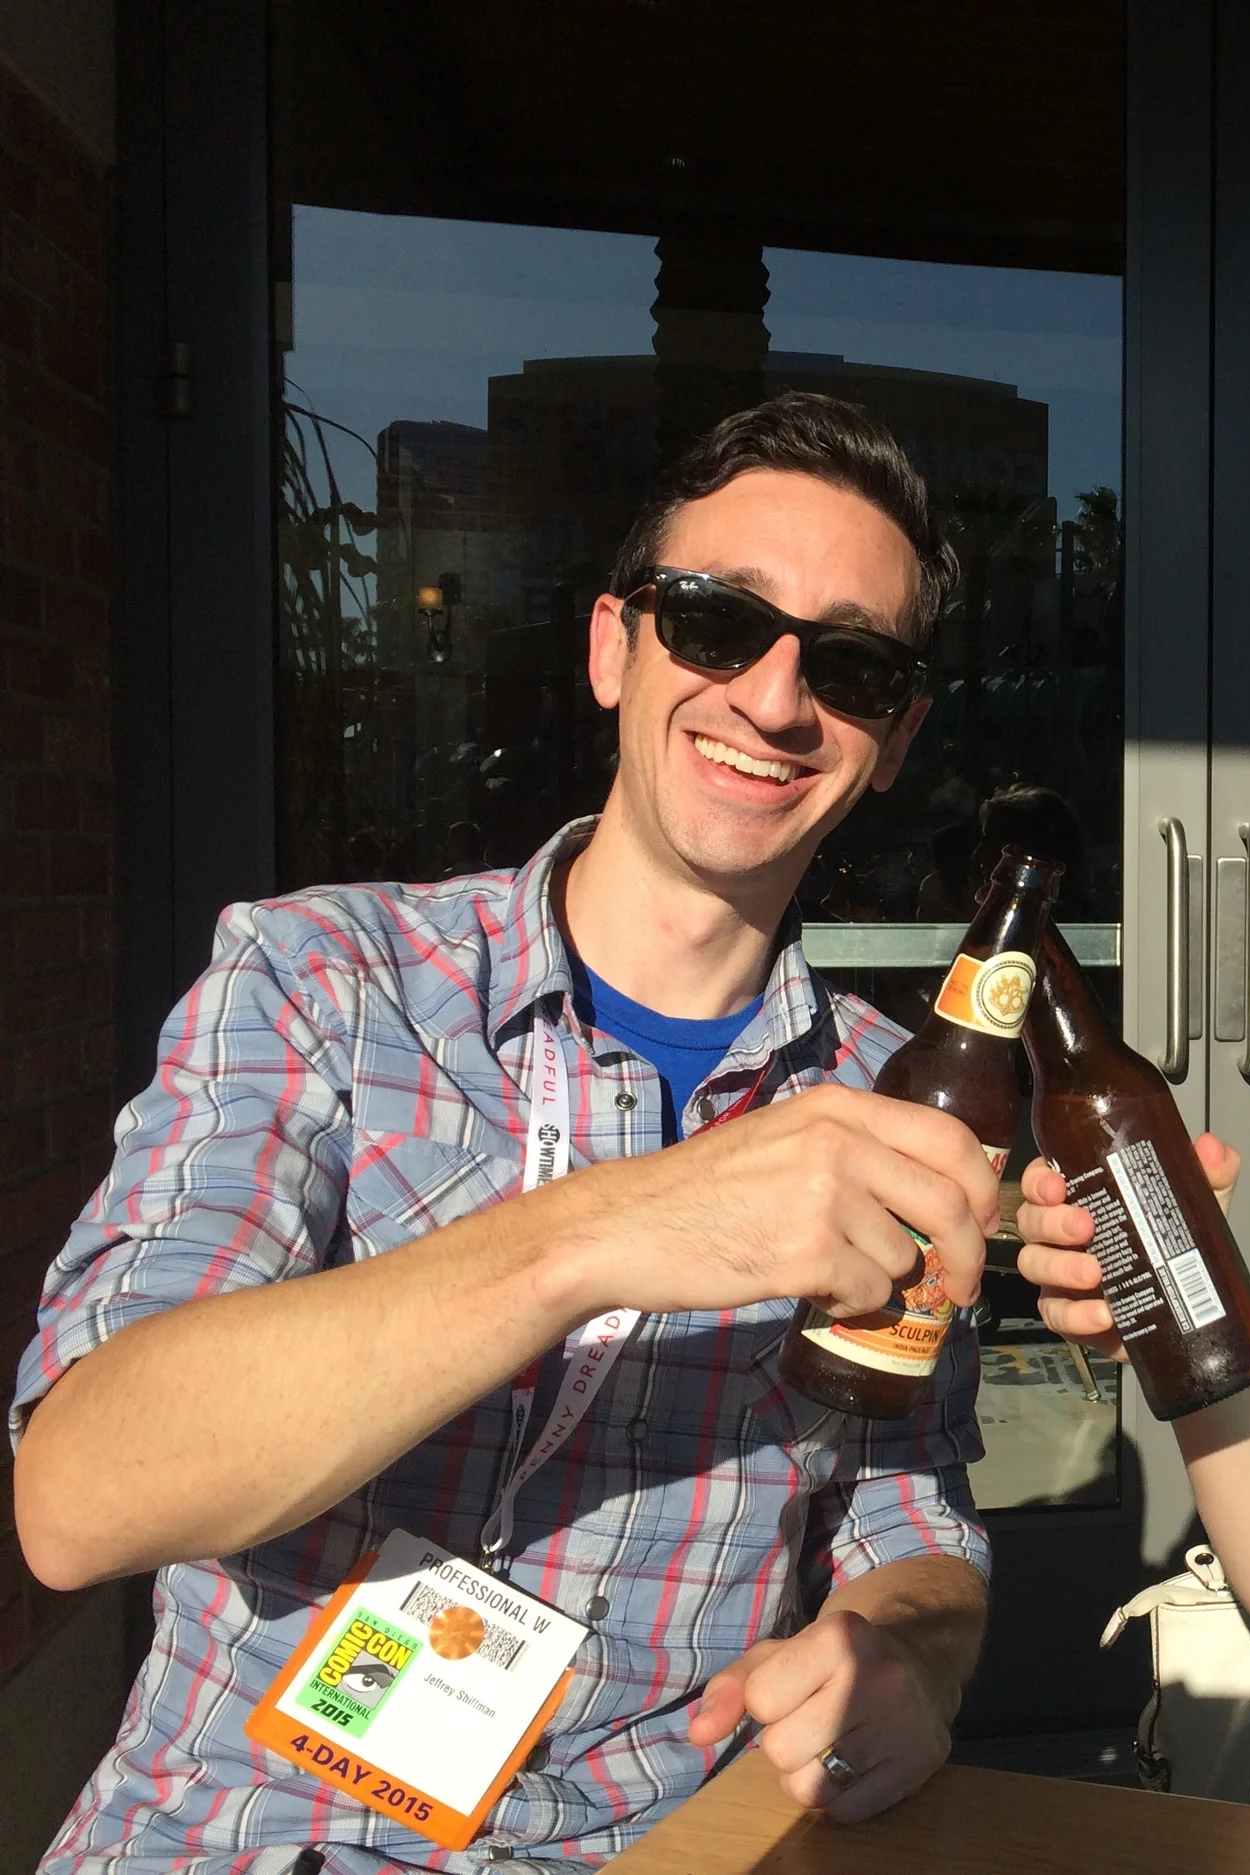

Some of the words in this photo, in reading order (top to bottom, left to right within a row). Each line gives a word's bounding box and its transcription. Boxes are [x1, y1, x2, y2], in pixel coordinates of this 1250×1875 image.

[573, 1306, 628, 1394] DREAD
[890, 1323, 940, 1342] SCULPIN
[419, 1552, 528, 1625] PROFESSIONAL
[533, 1616, 551, 1634] W
[357, 1612, 378, 1626] SAN
[385, 1627, 418, 1650] DIEGO
[366, 1632, 413, 1670] CON
[319, 1621, 373, 1686] COMIC
[310, 1679, 372, 1719] INTERNATIONAL
[311, 1698, 354, 1727] 2015
[289, 1734, 372, 1785] 4-DAY
[371, 1780, 434, 1821] 2015
